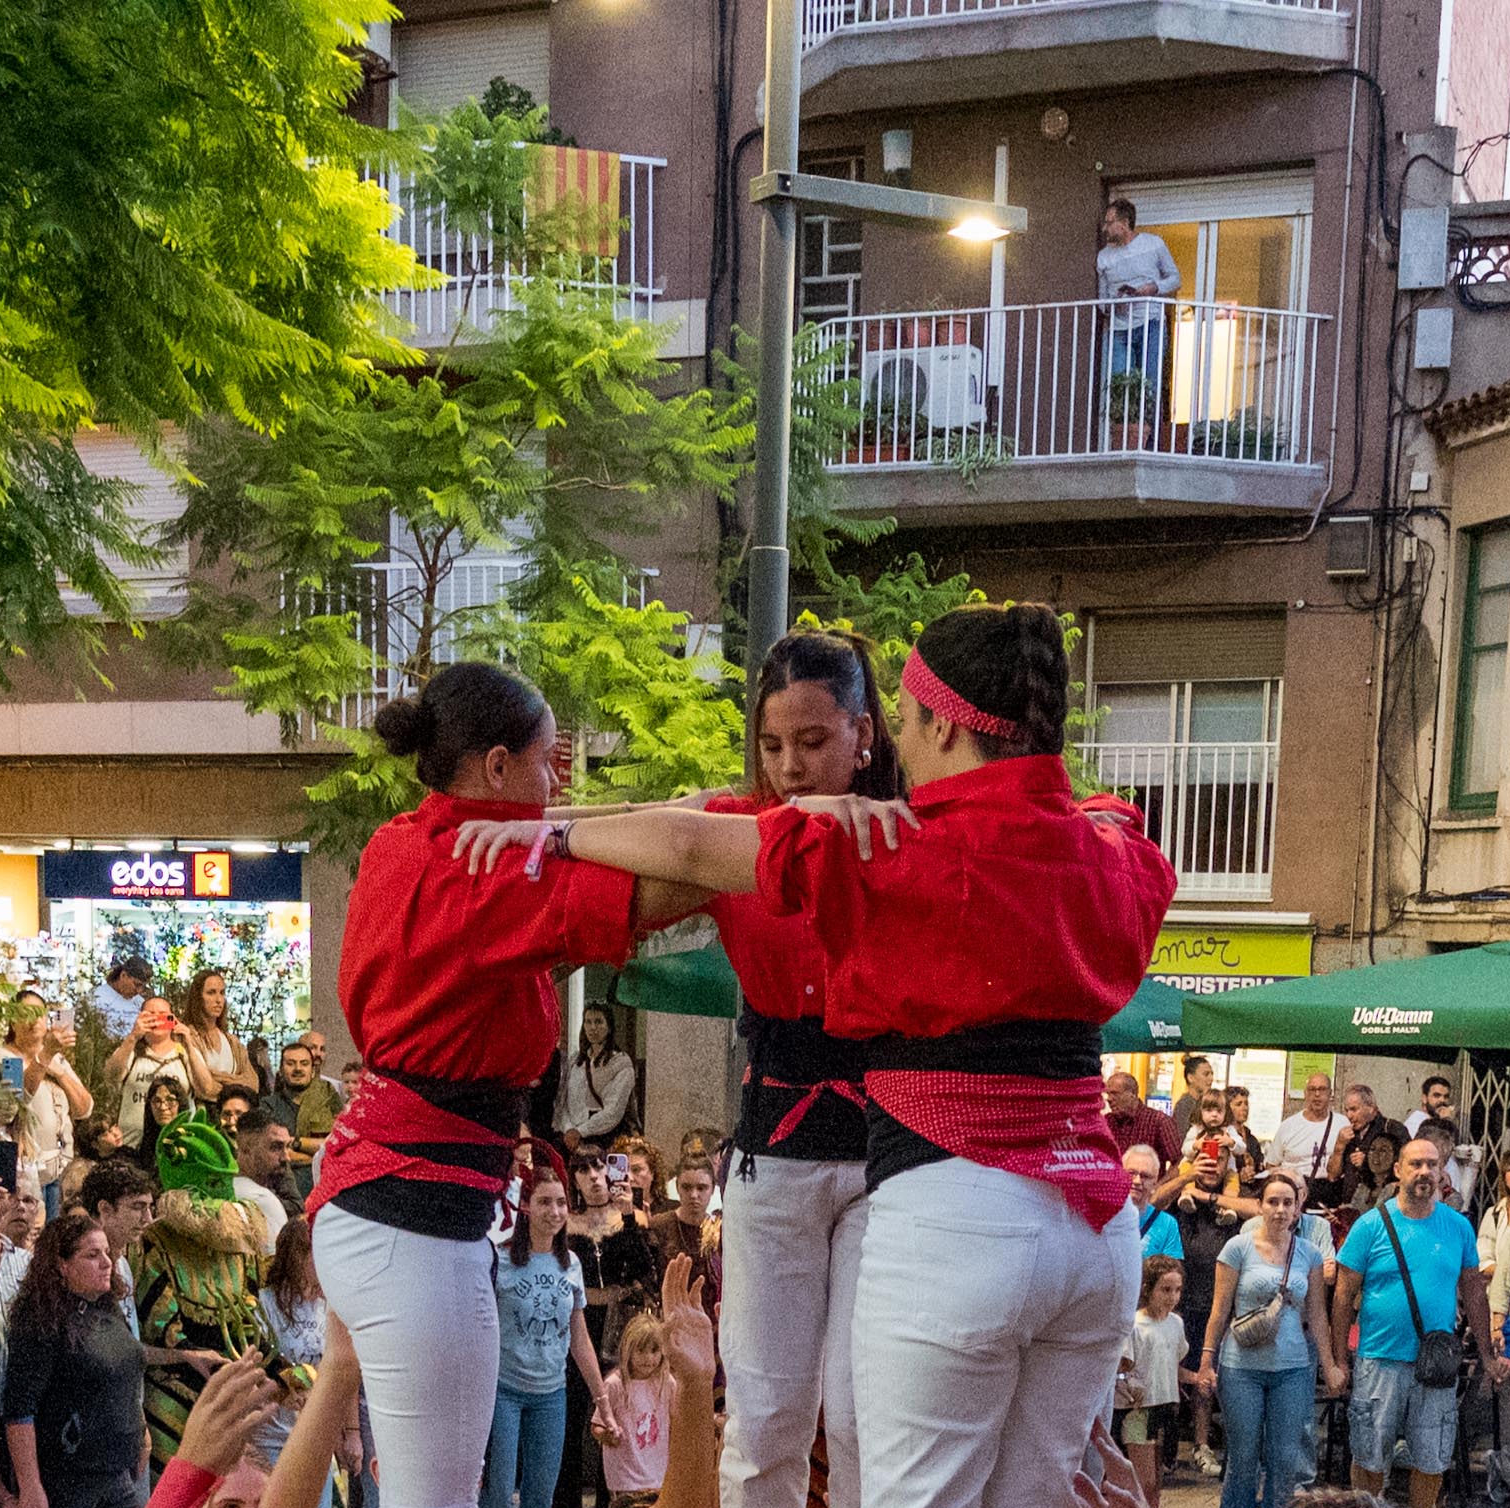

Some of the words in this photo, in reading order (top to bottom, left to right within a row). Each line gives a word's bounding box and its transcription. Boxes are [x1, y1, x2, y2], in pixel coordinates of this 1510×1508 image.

[110, 852, 187, 887] edos
[112, 886, 150, 897] everything
[1351, 1006, 1434, 1026] Voll-Damm
[1361, 1026, 1391, 1034] DOBLE
[1392, 1026, 1420, 1034] MALTA
[534, 1273, 555, 1285] 100
